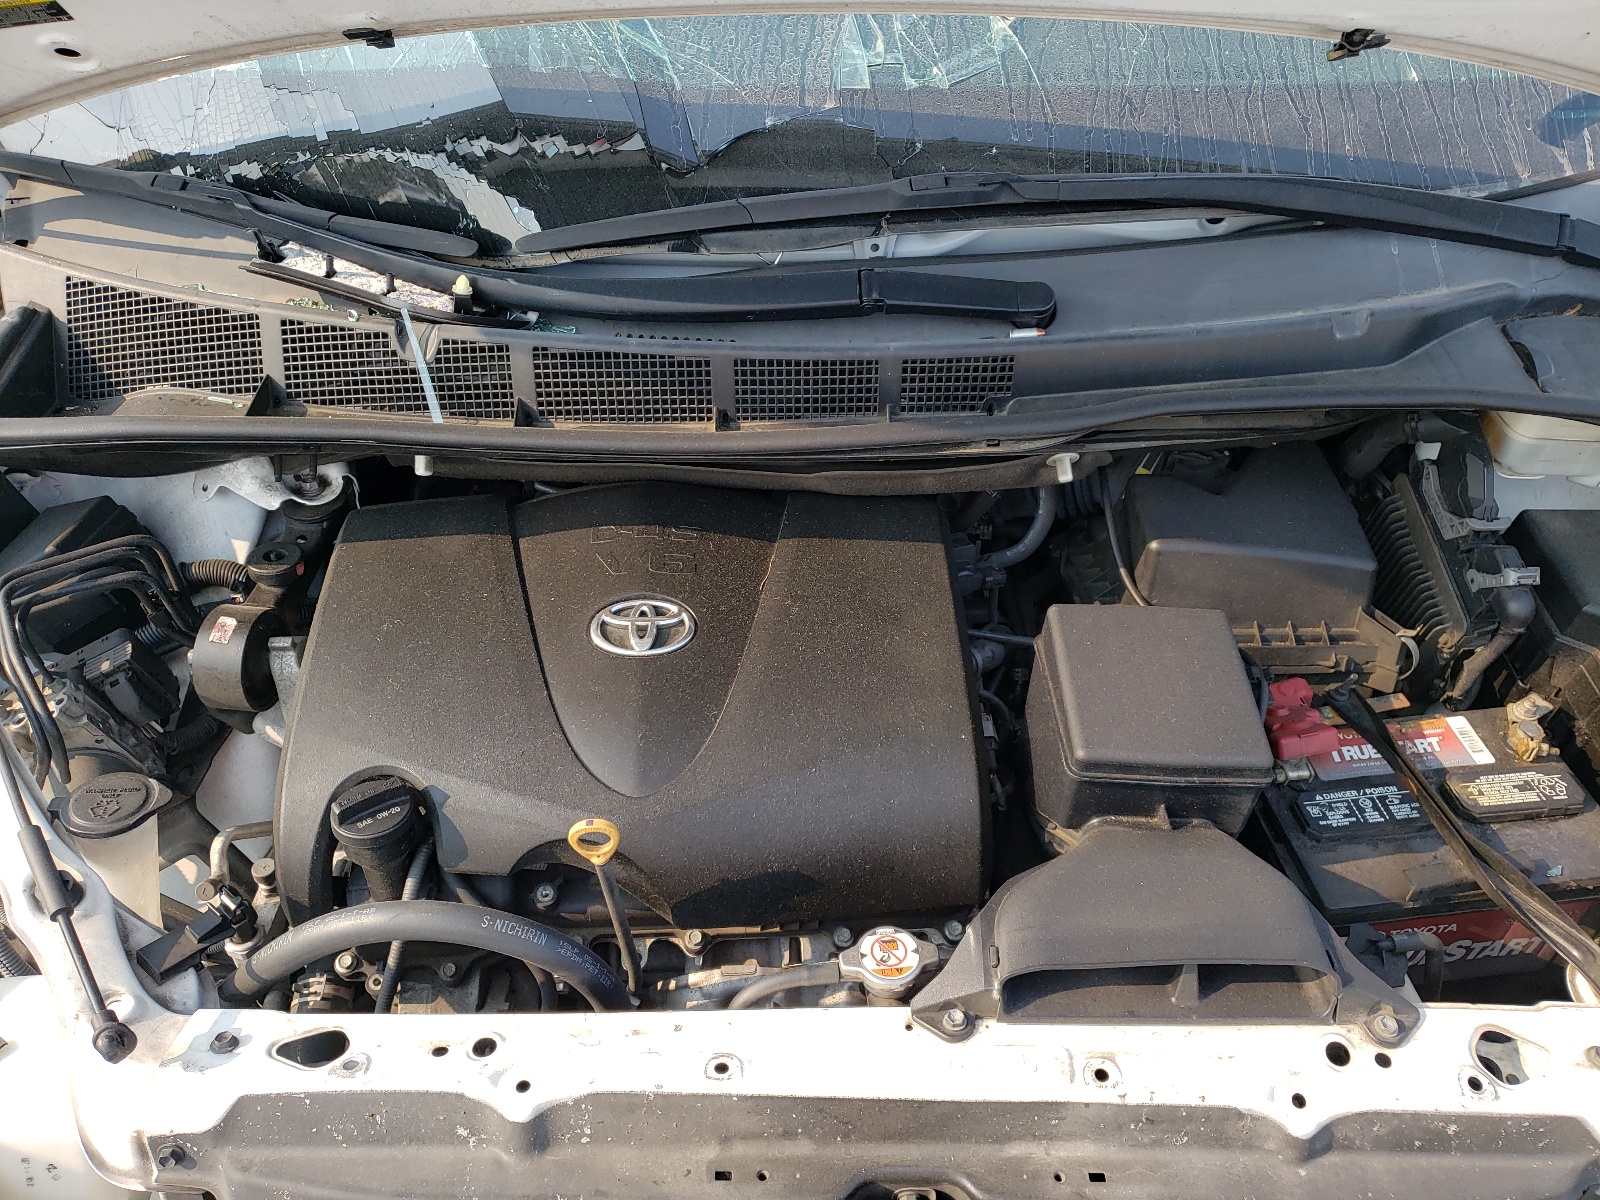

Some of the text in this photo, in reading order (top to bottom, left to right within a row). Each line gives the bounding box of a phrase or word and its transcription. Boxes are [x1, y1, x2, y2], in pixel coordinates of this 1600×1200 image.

[1322, 790, 1359, 800] DANGER
[1364, 786, 1398, 795] POISON
[356, 806, 401, 829] SAE 0W-20
